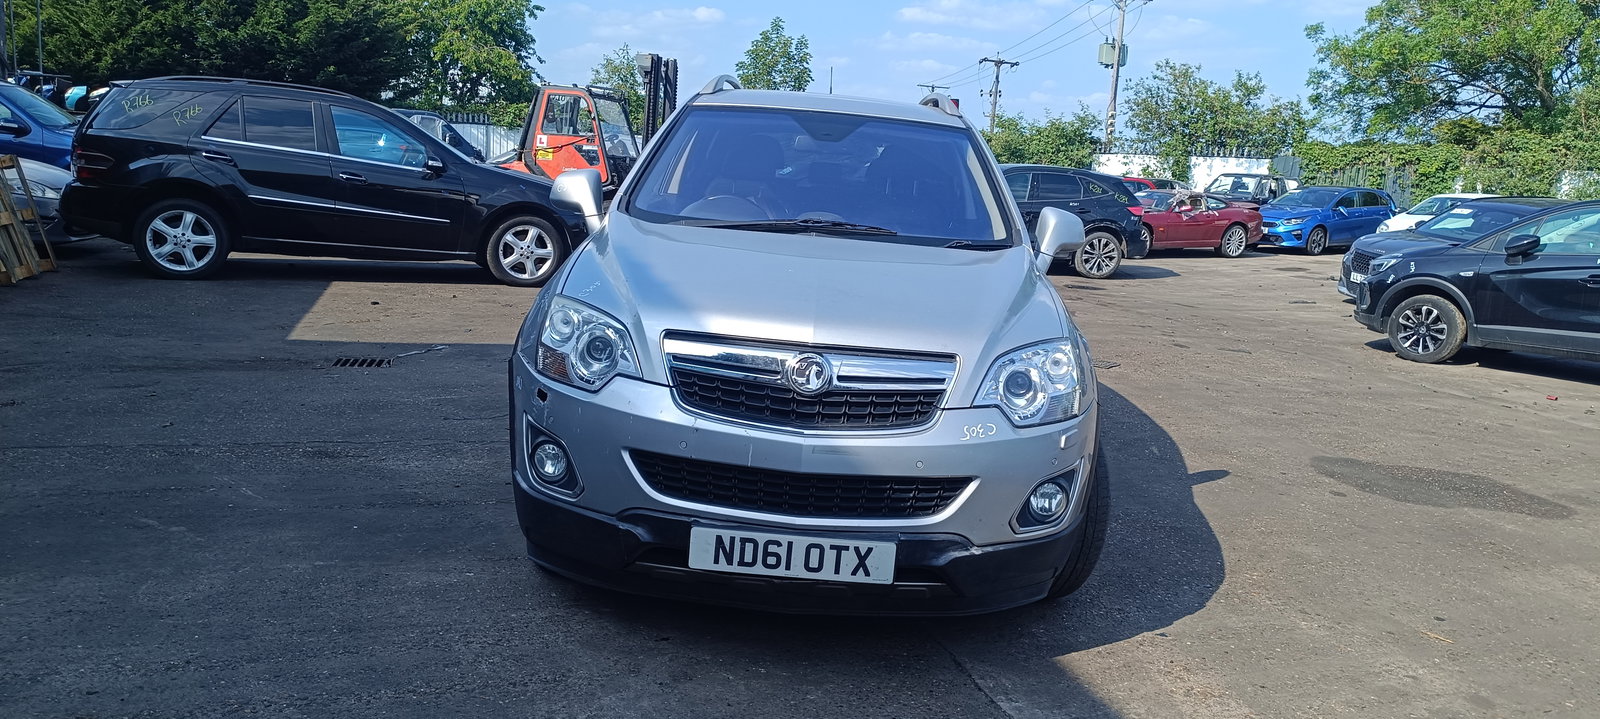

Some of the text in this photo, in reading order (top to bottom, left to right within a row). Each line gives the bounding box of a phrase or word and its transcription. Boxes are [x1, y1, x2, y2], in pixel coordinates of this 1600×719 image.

[960, 423, 997, 441] C305
[713, 534, 874, 577] ND61 OTX
